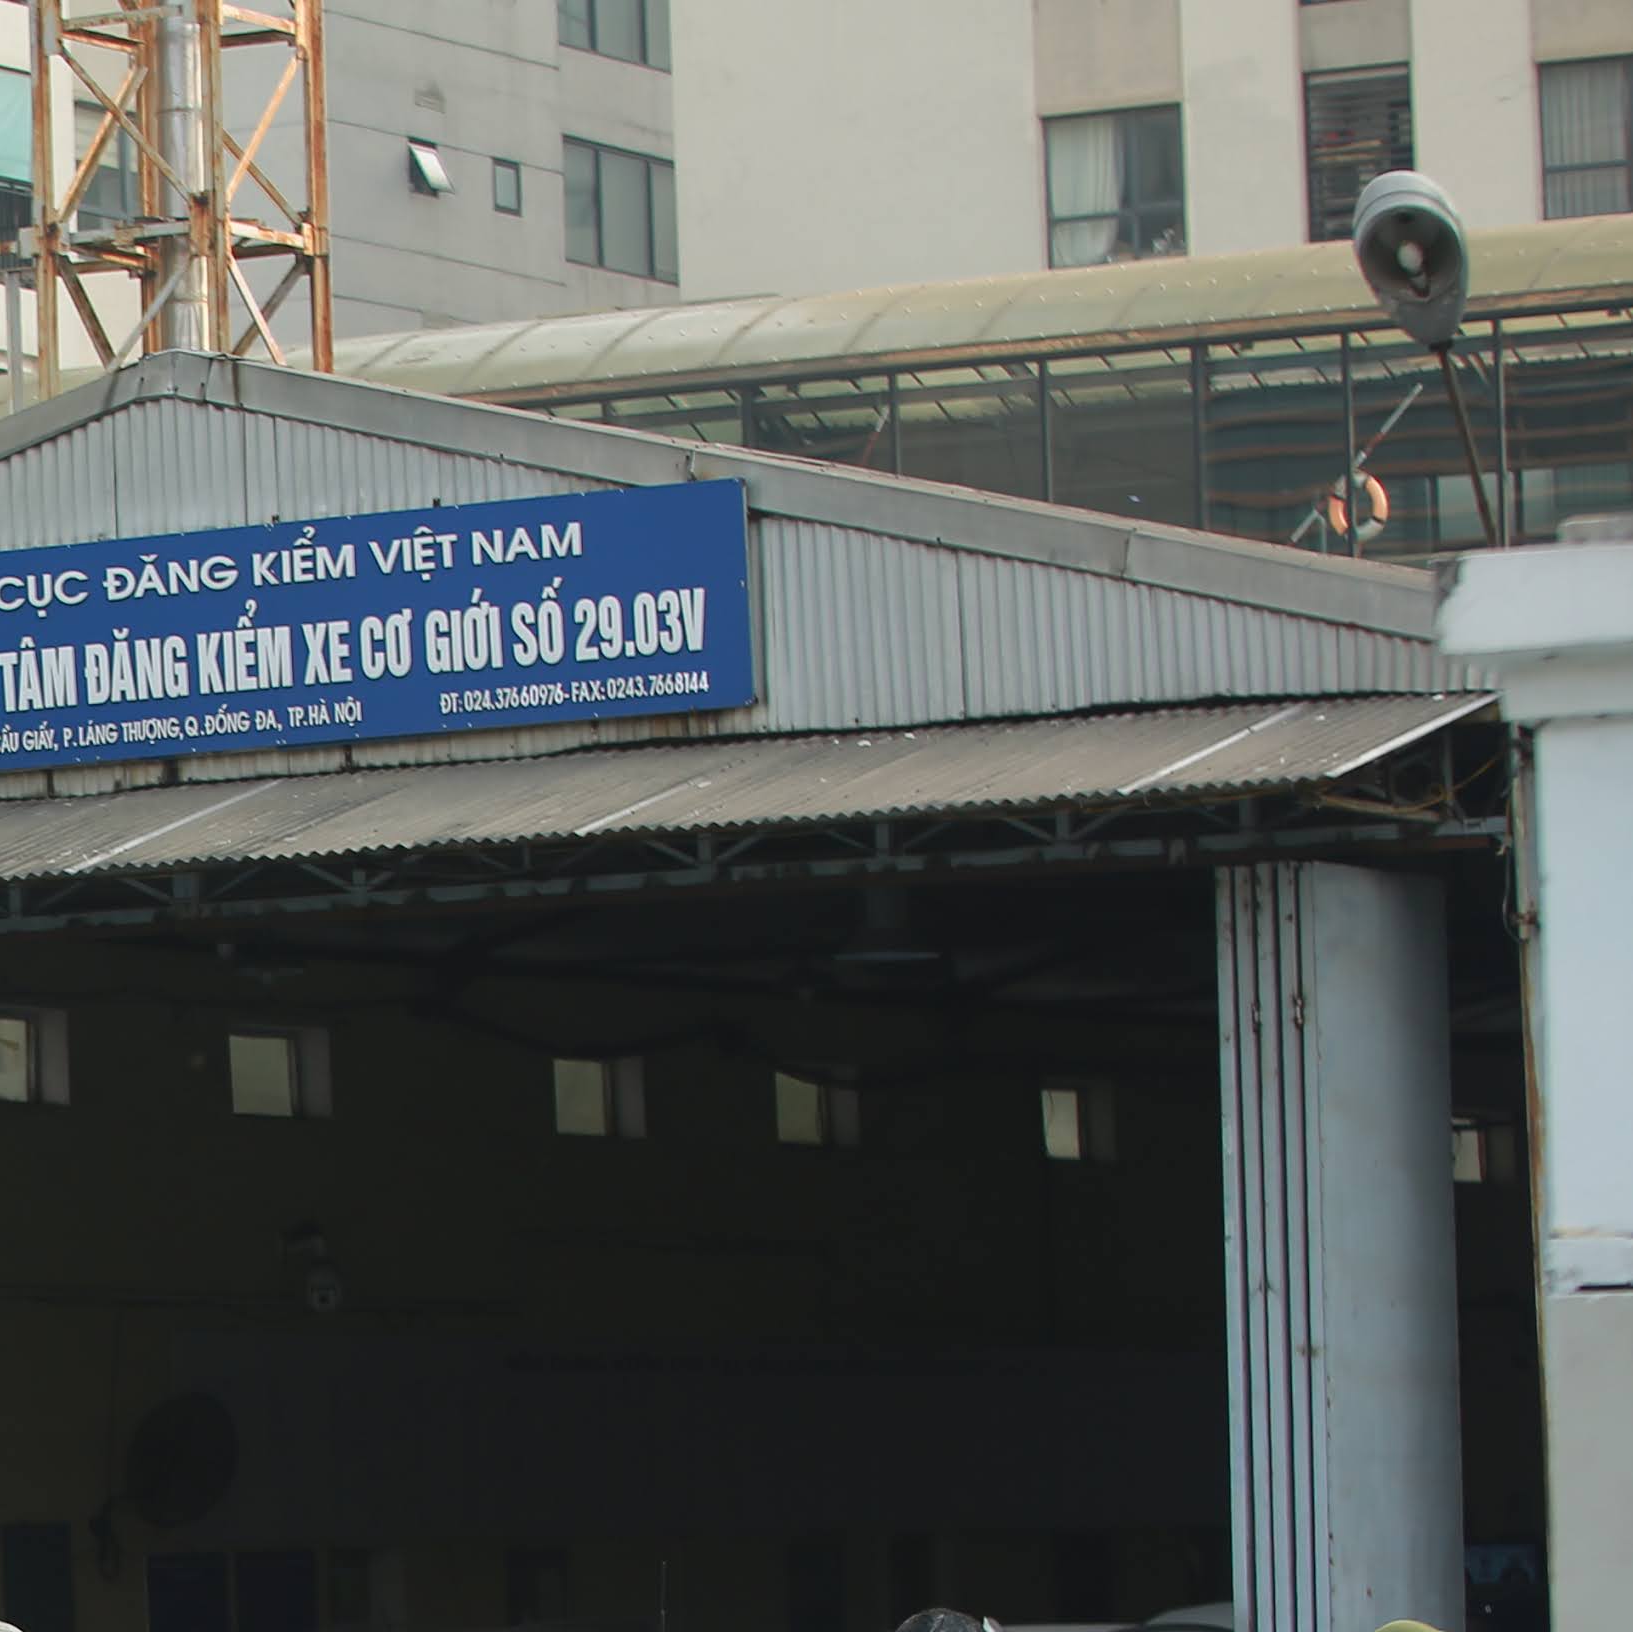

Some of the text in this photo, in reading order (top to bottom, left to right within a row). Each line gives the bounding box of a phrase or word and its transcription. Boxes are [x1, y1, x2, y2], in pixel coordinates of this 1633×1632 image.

[103, 553, 239, 601] ĐĂNG
[251, 525, 356, 586] KIỂM
[367, 526, 458, 581] VIỆT
[471, 521, 583, 567] NAM
[84, 625, 190, 705] ĐĂNG
[196, 598, 294, 695] KIỂM
[301, 620, 353, 686] XE
[360, 607, 413, 679] CƠ
[425, 587, 503, 673] GIỚI
[511, 576, 564, 666] SỐ
[574, 587, 705, 662] 29.03V
[334, 695, 362, 727] NỘI
